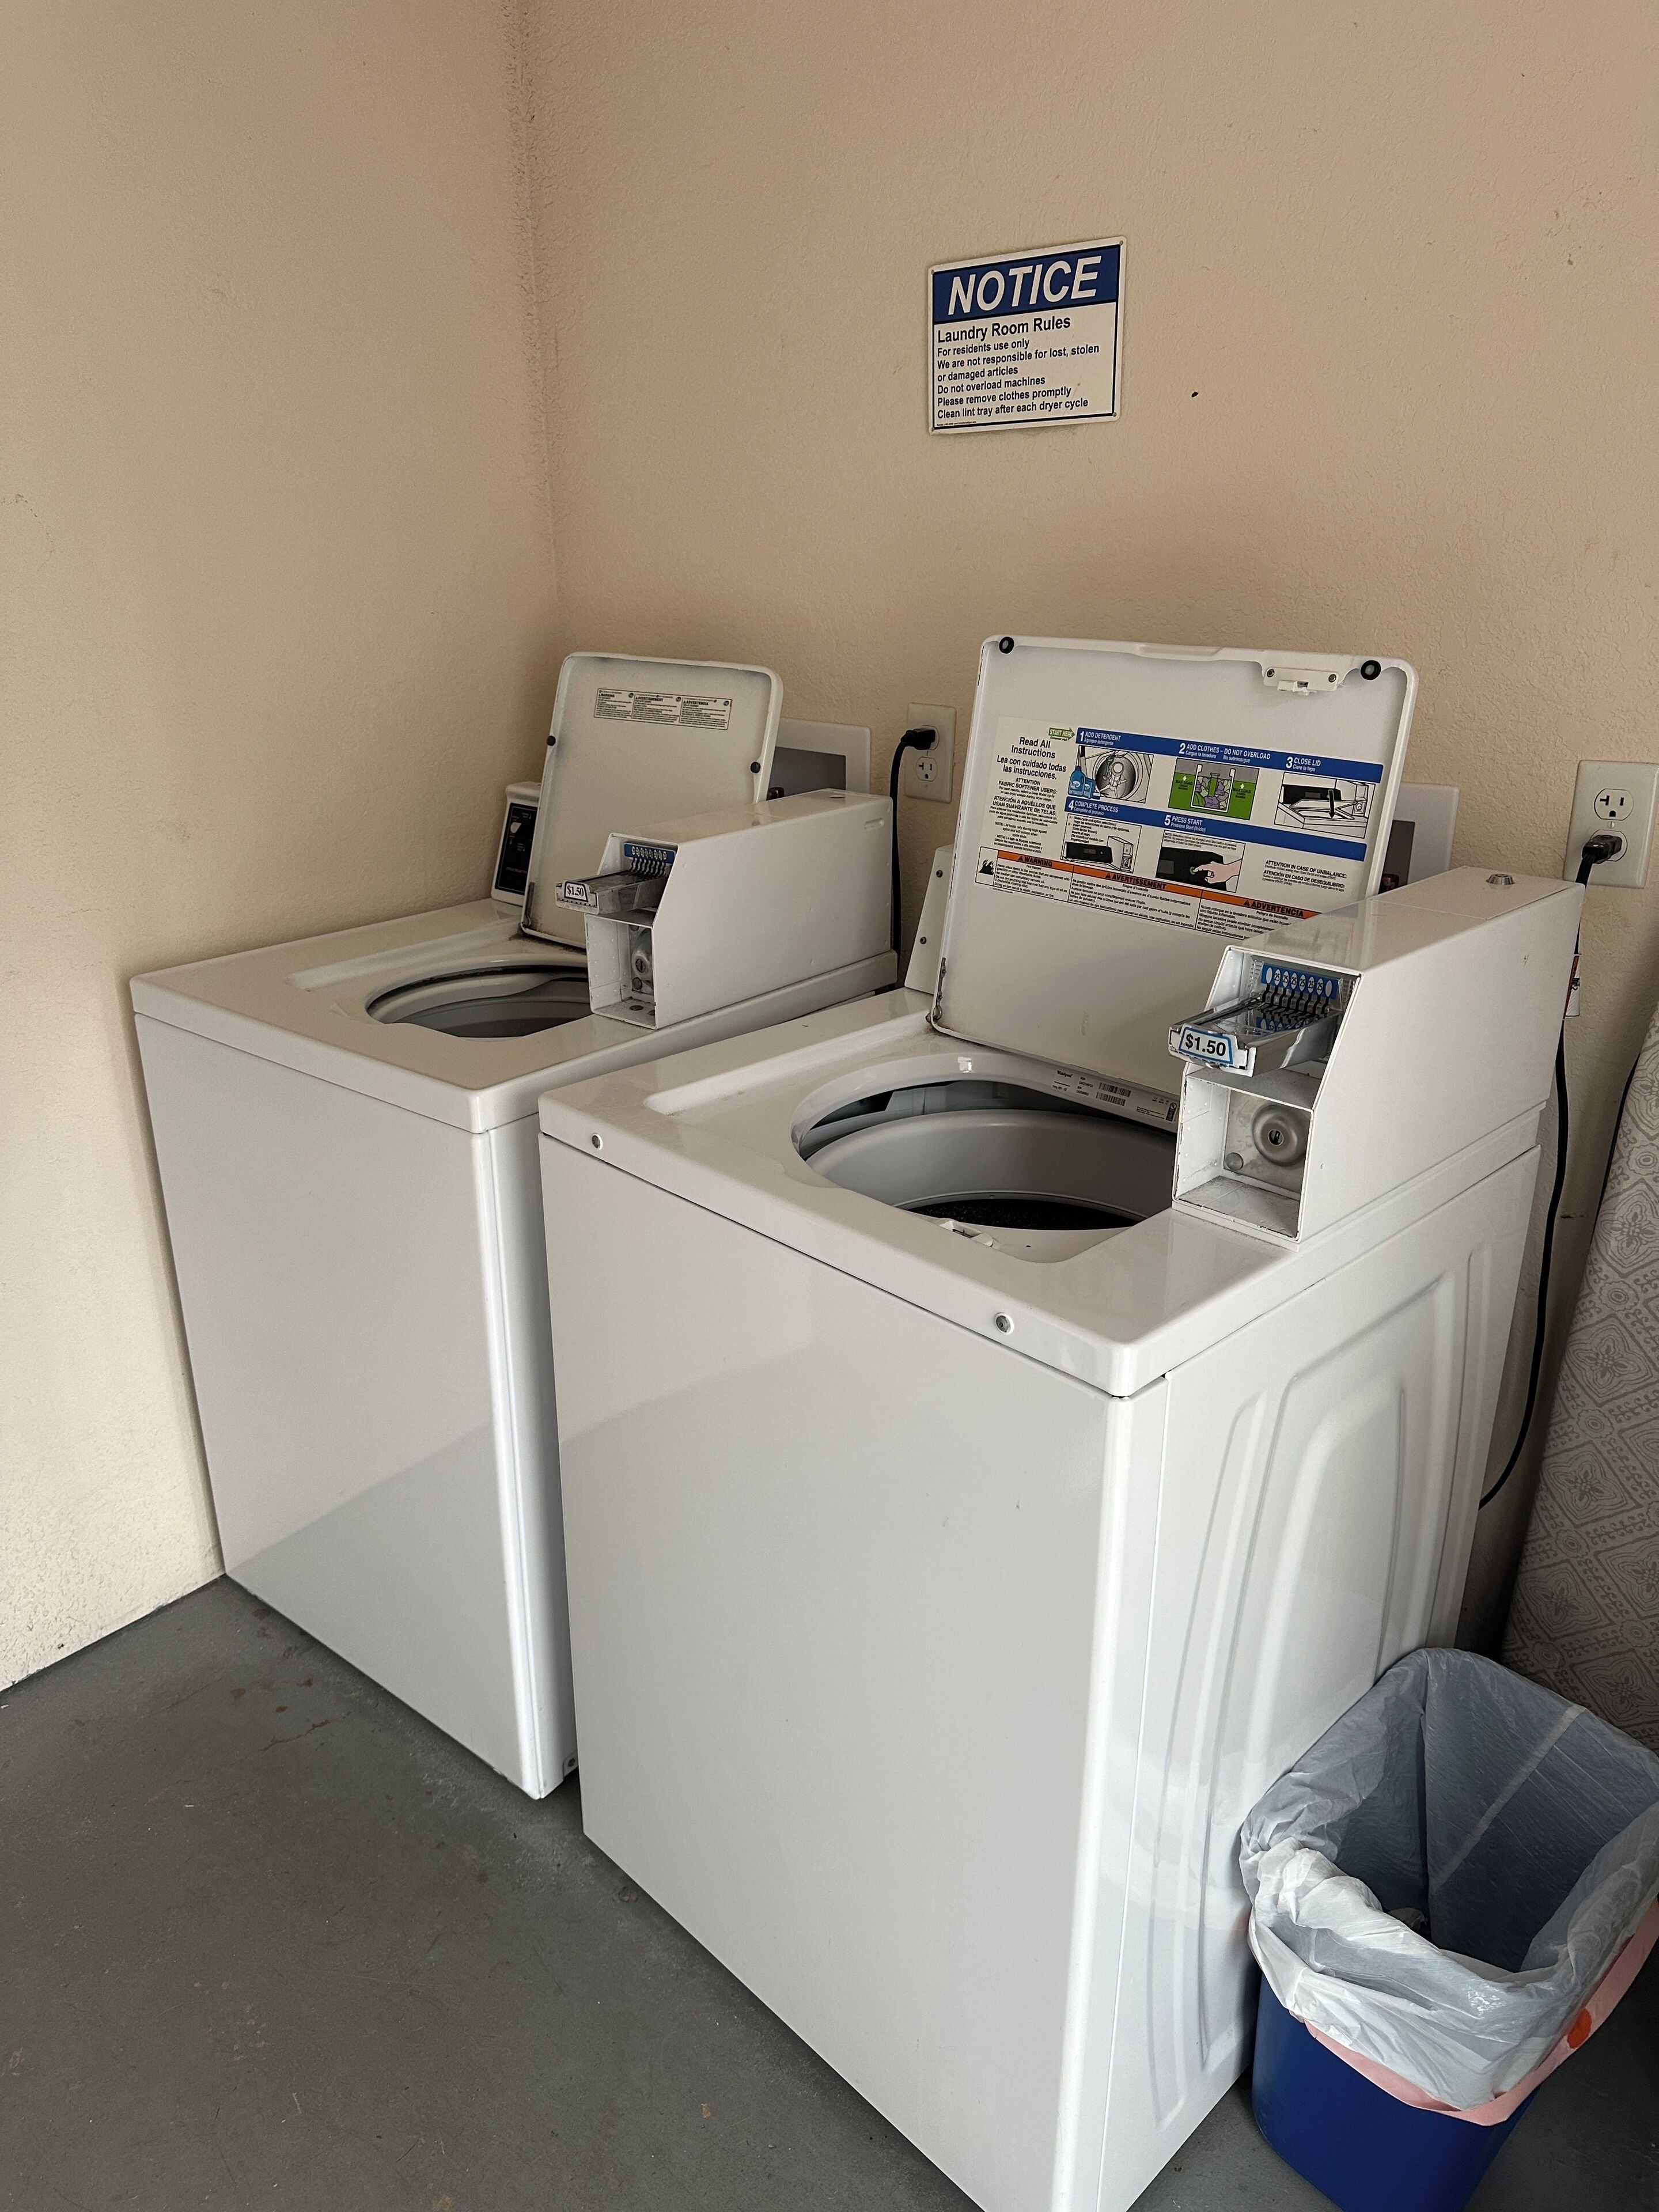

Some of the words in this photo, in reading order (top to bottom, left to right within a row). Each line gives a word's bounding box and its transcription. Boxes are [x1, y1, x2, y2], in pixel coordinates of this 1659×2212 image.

[948, 256, 1101, 315] NOTICE
[938, 326, 987, 343] Laundry
[992, 321, 1029, 336] Room
[1033, 316, 1070, 332] Rules
[938, 347, 950, 357] For
[953, 343, 991, 355] residents
[994, 342, 1008, 351] use
[1012, 339, 1029, 349] only
[938, 360, 950, 369] We
[967, 357, 980, 366] not
[983, 351, 1032, 365] responsible
[1035, 350, 1047, 359] for
[1050, 347, 1069, 358] lost,
[1071, 345, 1099, 355] stolen
[948, 369, 985, 381] damaged
[987, 366, 1018, 377] articles
[938, 385, 948, 394] Do
[951, 384, 964, 393] not
[967, 379, 1002, 391] overload
[1005, 377, 1045, 388] machines
[938, 396, 964, 407] Please
[967, 395, 996, 404] remove
[999, 390, 1029, 402] clothes
[1032, 387, 1071, 400] promptly
[938, 408, 960, 419] Clean
[963, 407, 975, 417] lint
[978, 406, 993, 416] tray
[995, 404, 1014, 414] after
[1017, 402, 1037, 412] each
[1040, 400, 1062, 411] dryer
[1065, 397, 1088, 408] cycle
[1080, 731, 1084, 741] 1
[1095, 733, 1121, 741] DETERGENT
[1019, 737, 1039, 747] Read
[1040, 740, 1051, 748] All
[1012, 745, 1055, 758] Instructions
[1179, 743, 1185, 754] 2
[1243, 751, 1271, 760] OVERLOAD
[997, 755, 1007, 763] Lea
[1022, 760, 1047, 769] cuidado
[1049, 763, 1066, 772] todas
[1286, 756, 1293, 768] 3
[1014, 767, 1056, 779] instrucciones.
[1016, 783, 1040, 791] SOFTENER
[994, 796, 1016, 804] ATENCIÓN
[1069, 800, 1074, 810] 4
[1075, 801, 1097, 809] COMPLETE
[1098, 804, 1119, 812] PROCESS
[1006, 802, 1032, 812] SUAVIZANTE
[1164, 815, 1171, 825] 5
[1024, 856, 1052, 867] WARNING
[1266, 860, 1290, 868] ATTENTION
[1317, 869, 1347, 878] UNBALANCE:
[1112, 873, 1167, 889] AVERTISSEMENT
[1311, 878, 1345, 888] DESEQUILIBRIO:
[567, 885, 584, 897] $1.50
[1251, 902, 1304, 917] ADVERTENCIA
[1274, 973, 1280, 981] 25
[1291, 977, 1297, 985] 25
[1300, 978, 1305, 987] 25
[1308, 980, 1313, 988] 25
[1317, 983, 1323, 991] 25
[1185, 1033, 1226, 1056] $1.50
